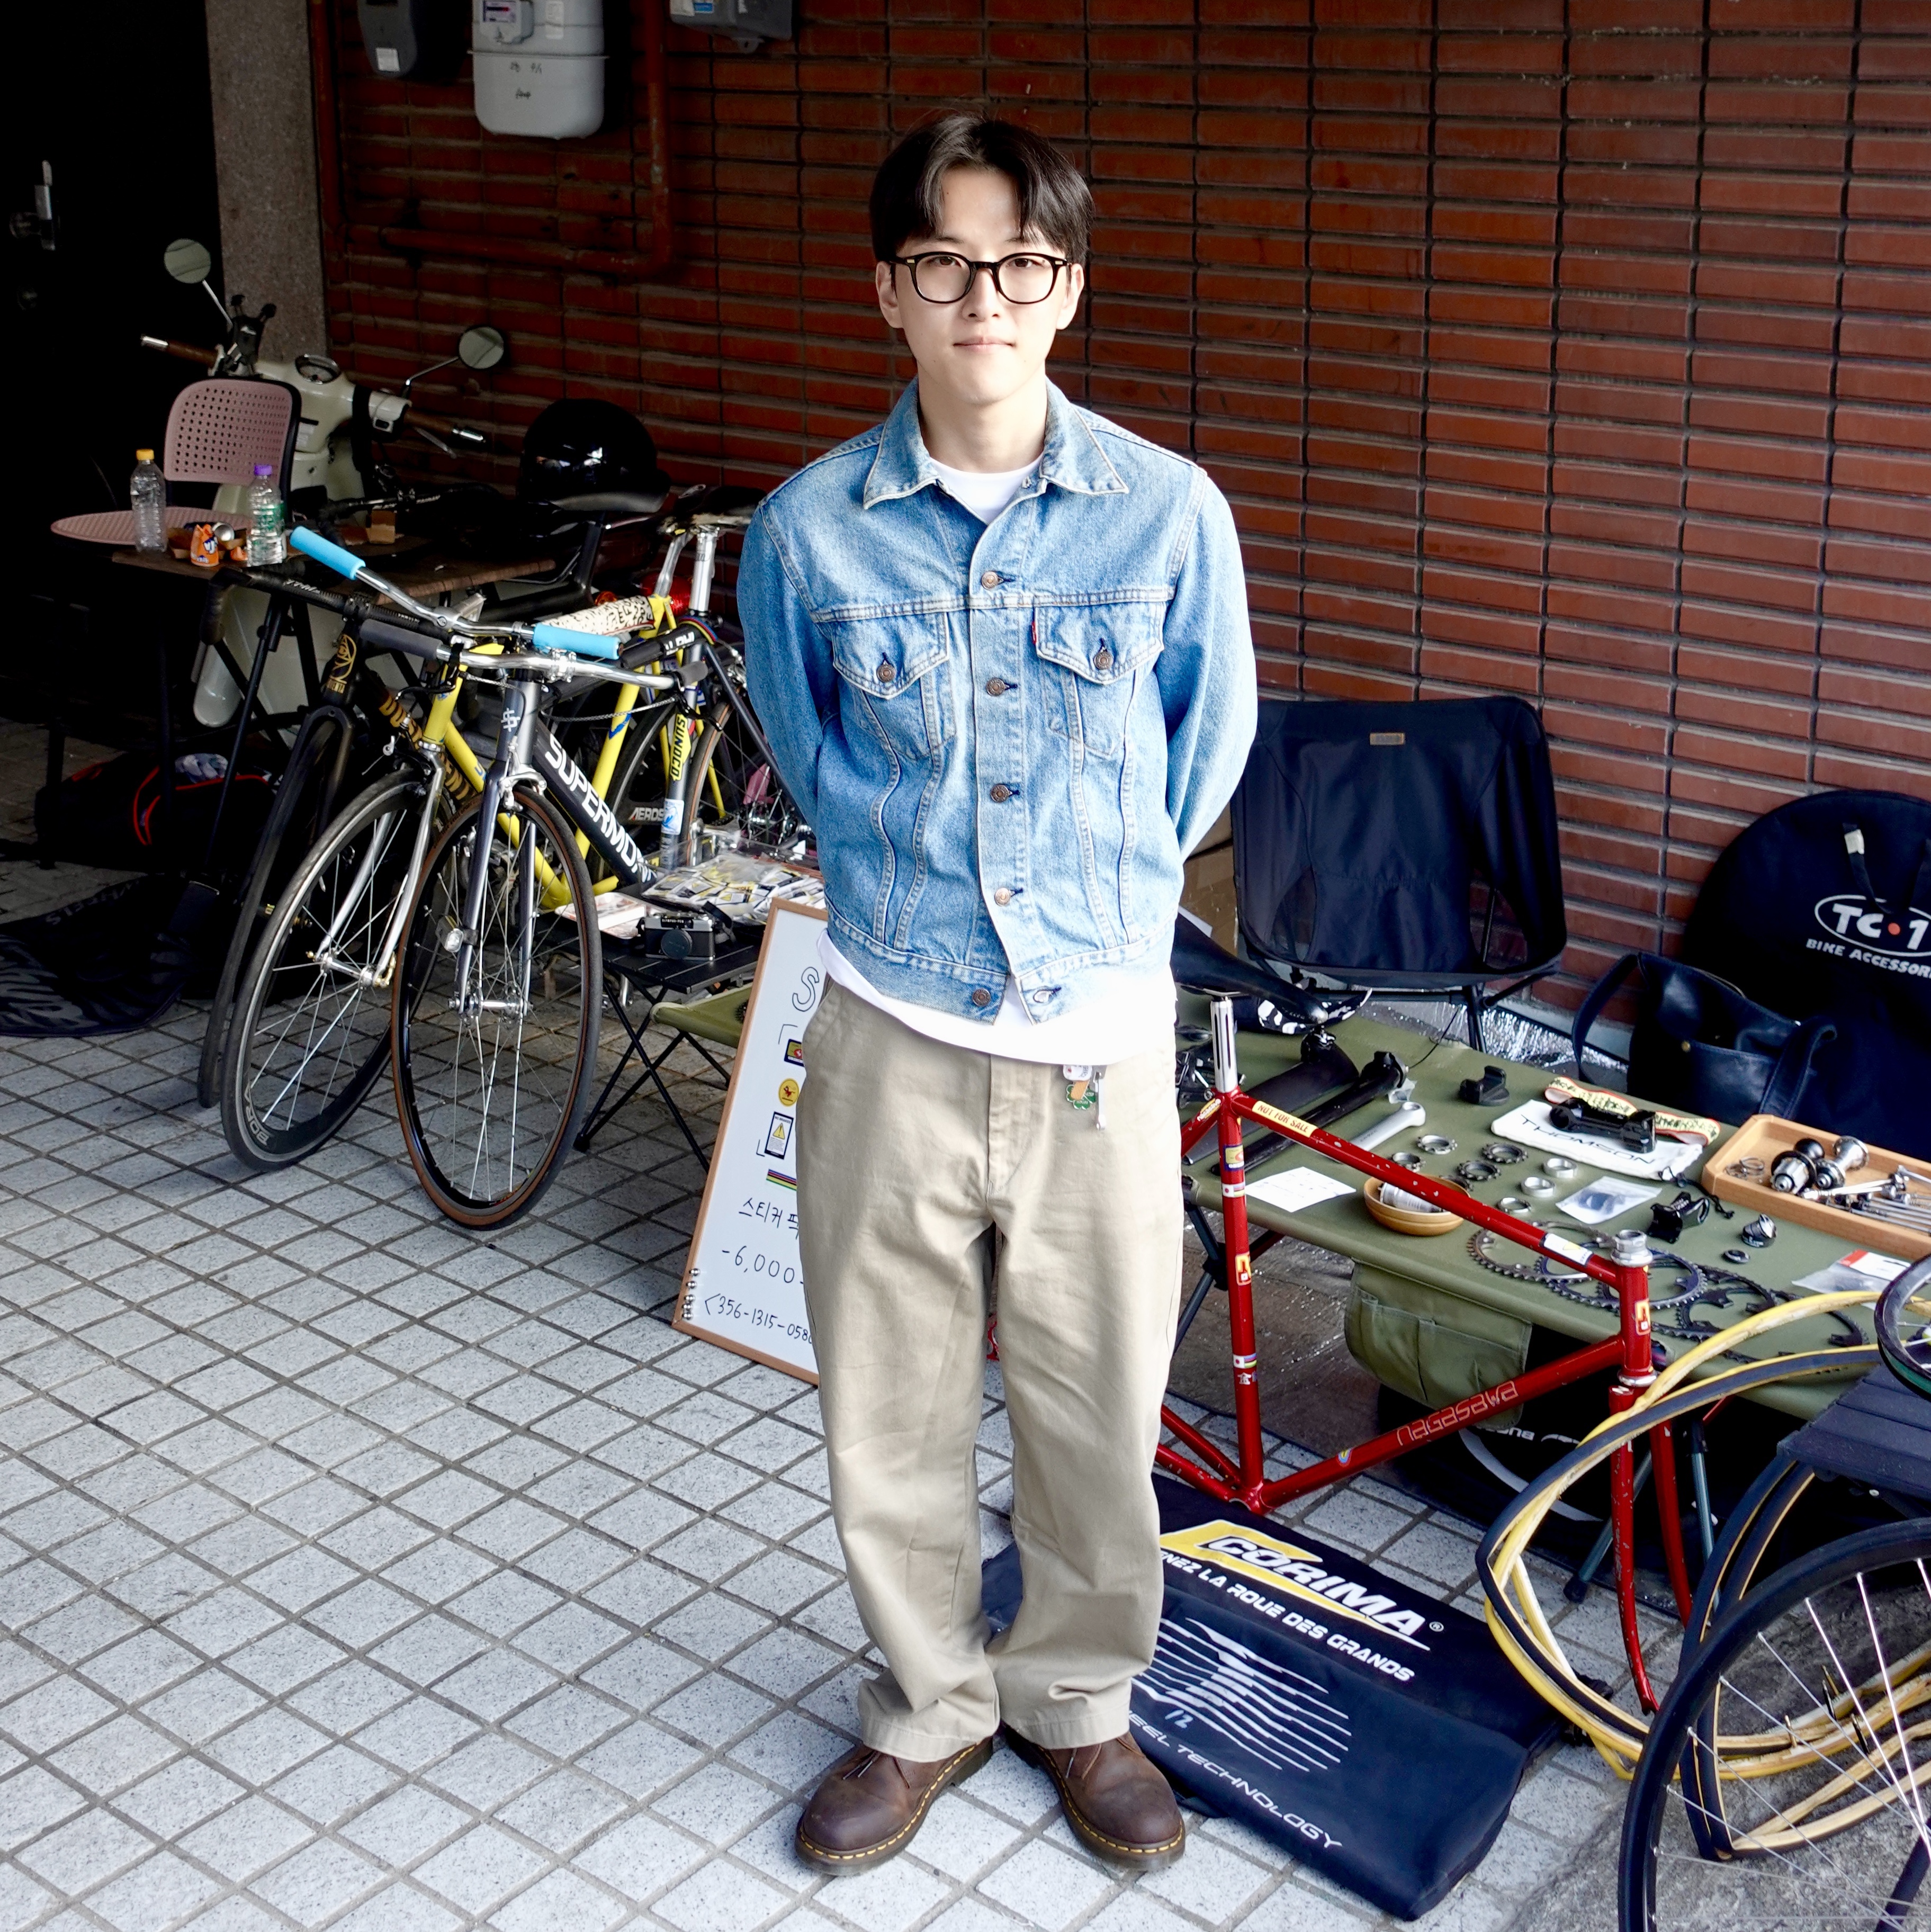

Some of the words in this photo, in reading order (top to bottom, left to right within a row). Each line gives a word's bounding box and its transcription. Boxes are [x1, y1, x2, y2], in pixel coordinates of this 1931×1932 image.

[671, 718, 685, 778] SUNOCO
[1806, 938, 1845, 956] BIKE
[1258, 1105, 1272, 1115] NOT
[1274, 1113, 1289, 1124] FOR
[1290, 1120, 1309, 1133] SALE
[1520, 1114, 1655, 1165] THOMSON
[739, 1198, 783, 1228] 스티커
[1208, 1538, 1425, 1636] CORIMA
[1198, 1568, 1227, 1588] LA
[1226, 1583, 1286, 1618] ROUE
[1282, 1612, 1328, 1639] DES
[1326, 1633, 1415, 1681] GRANDS
[1128, 1710, 1170, 1747] EEL
[1178, 1744, 1343, 1848] TECHNOLOGY
